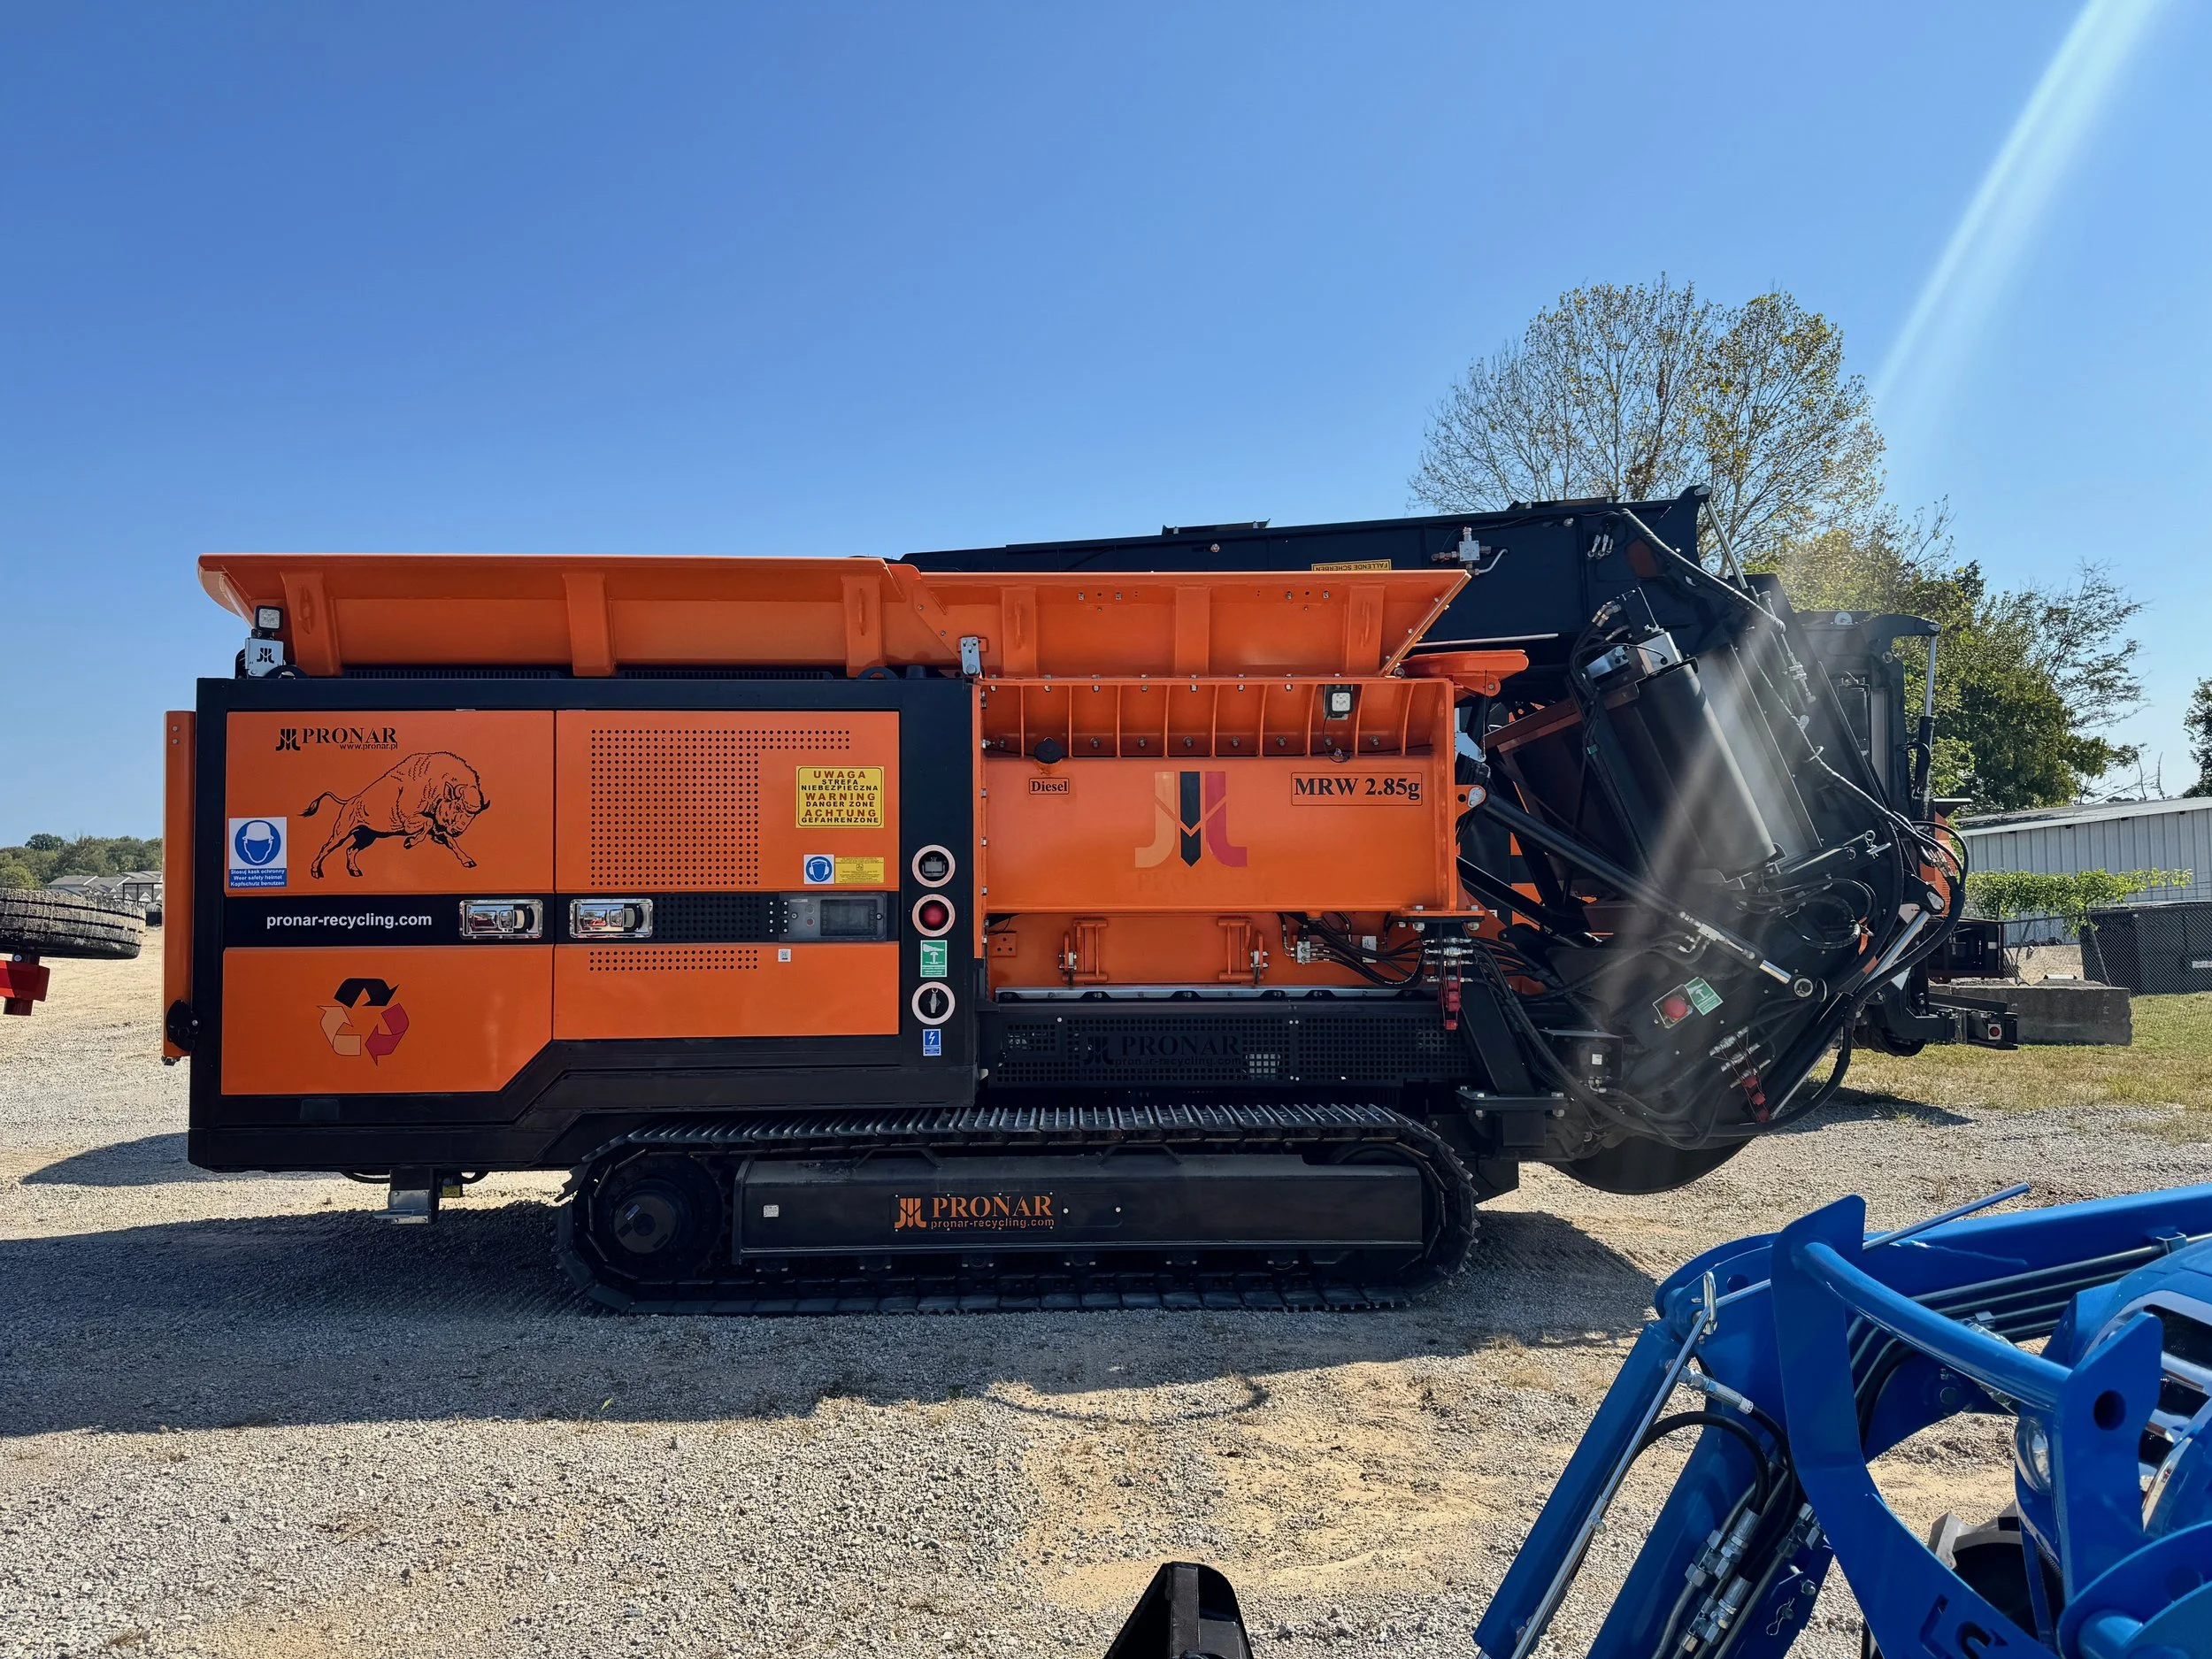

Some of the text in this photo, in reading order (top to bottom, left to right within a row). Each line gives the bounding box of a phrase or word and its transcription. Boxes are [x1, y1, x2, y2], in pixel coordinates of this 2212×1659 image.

[302, 727, 397, 744] PRONAR
[1031, 780, 1068, 792] Diesel
[1294, 778, 1420, 801] MRW 2.85g
[266, 912, 433, 929] pronar-recycling.com
[1122, 1035, 1240, 1056] PRONAR
[932, 1195, 1054, 1217] PRONAR
[931, 1217, 1055, 1230] pronar-recycling.com
